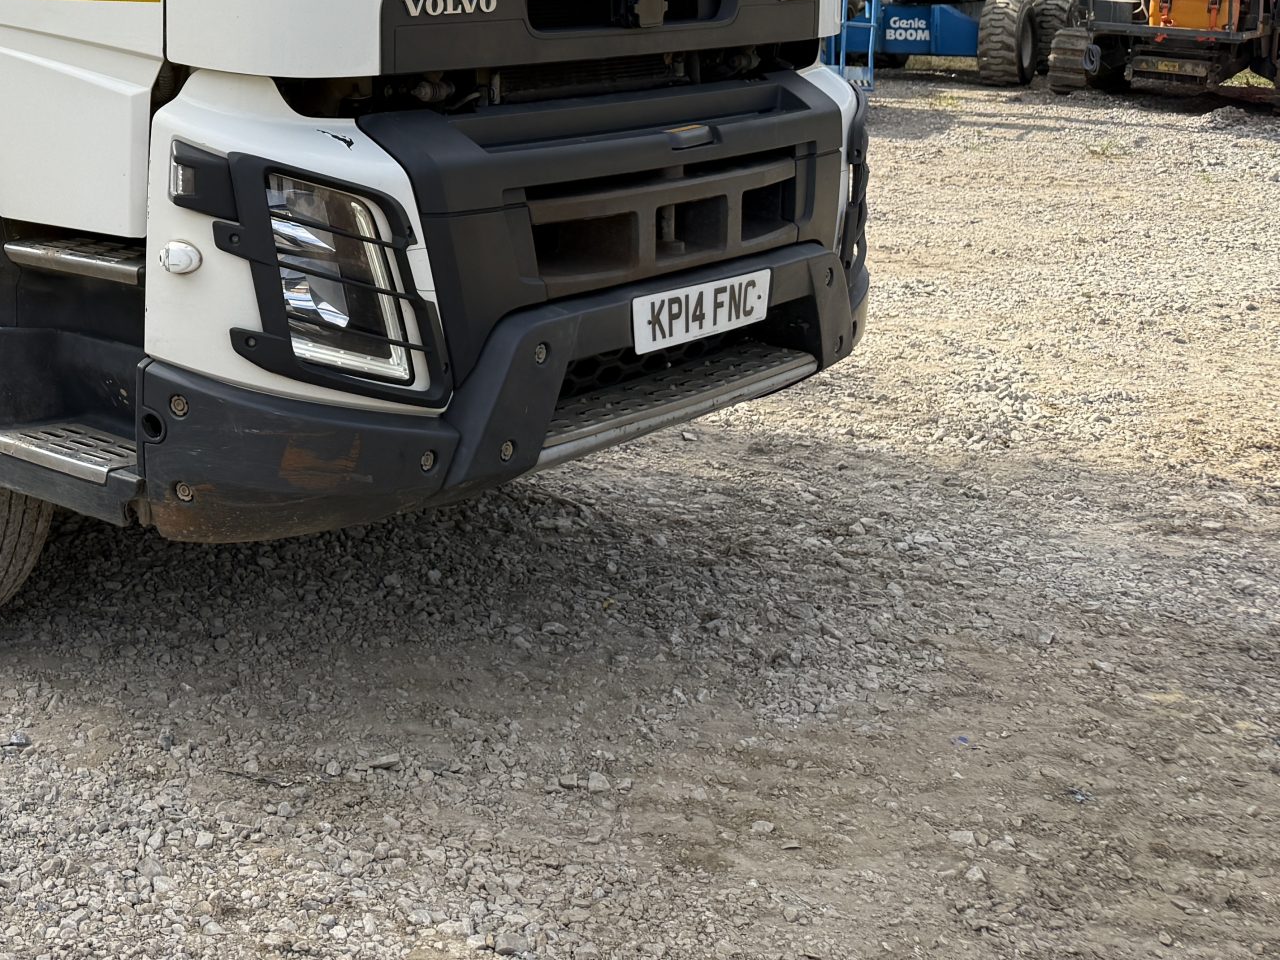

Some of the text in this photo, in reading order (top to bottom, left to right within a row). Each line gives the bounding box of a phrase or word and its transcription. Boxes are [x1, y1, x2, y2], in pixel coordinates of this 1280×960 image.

[889, 16, 927, 29] Genie
[885, 28, 930, 41] BOOM
[650, 279, 757, 342] KP14 FNC
